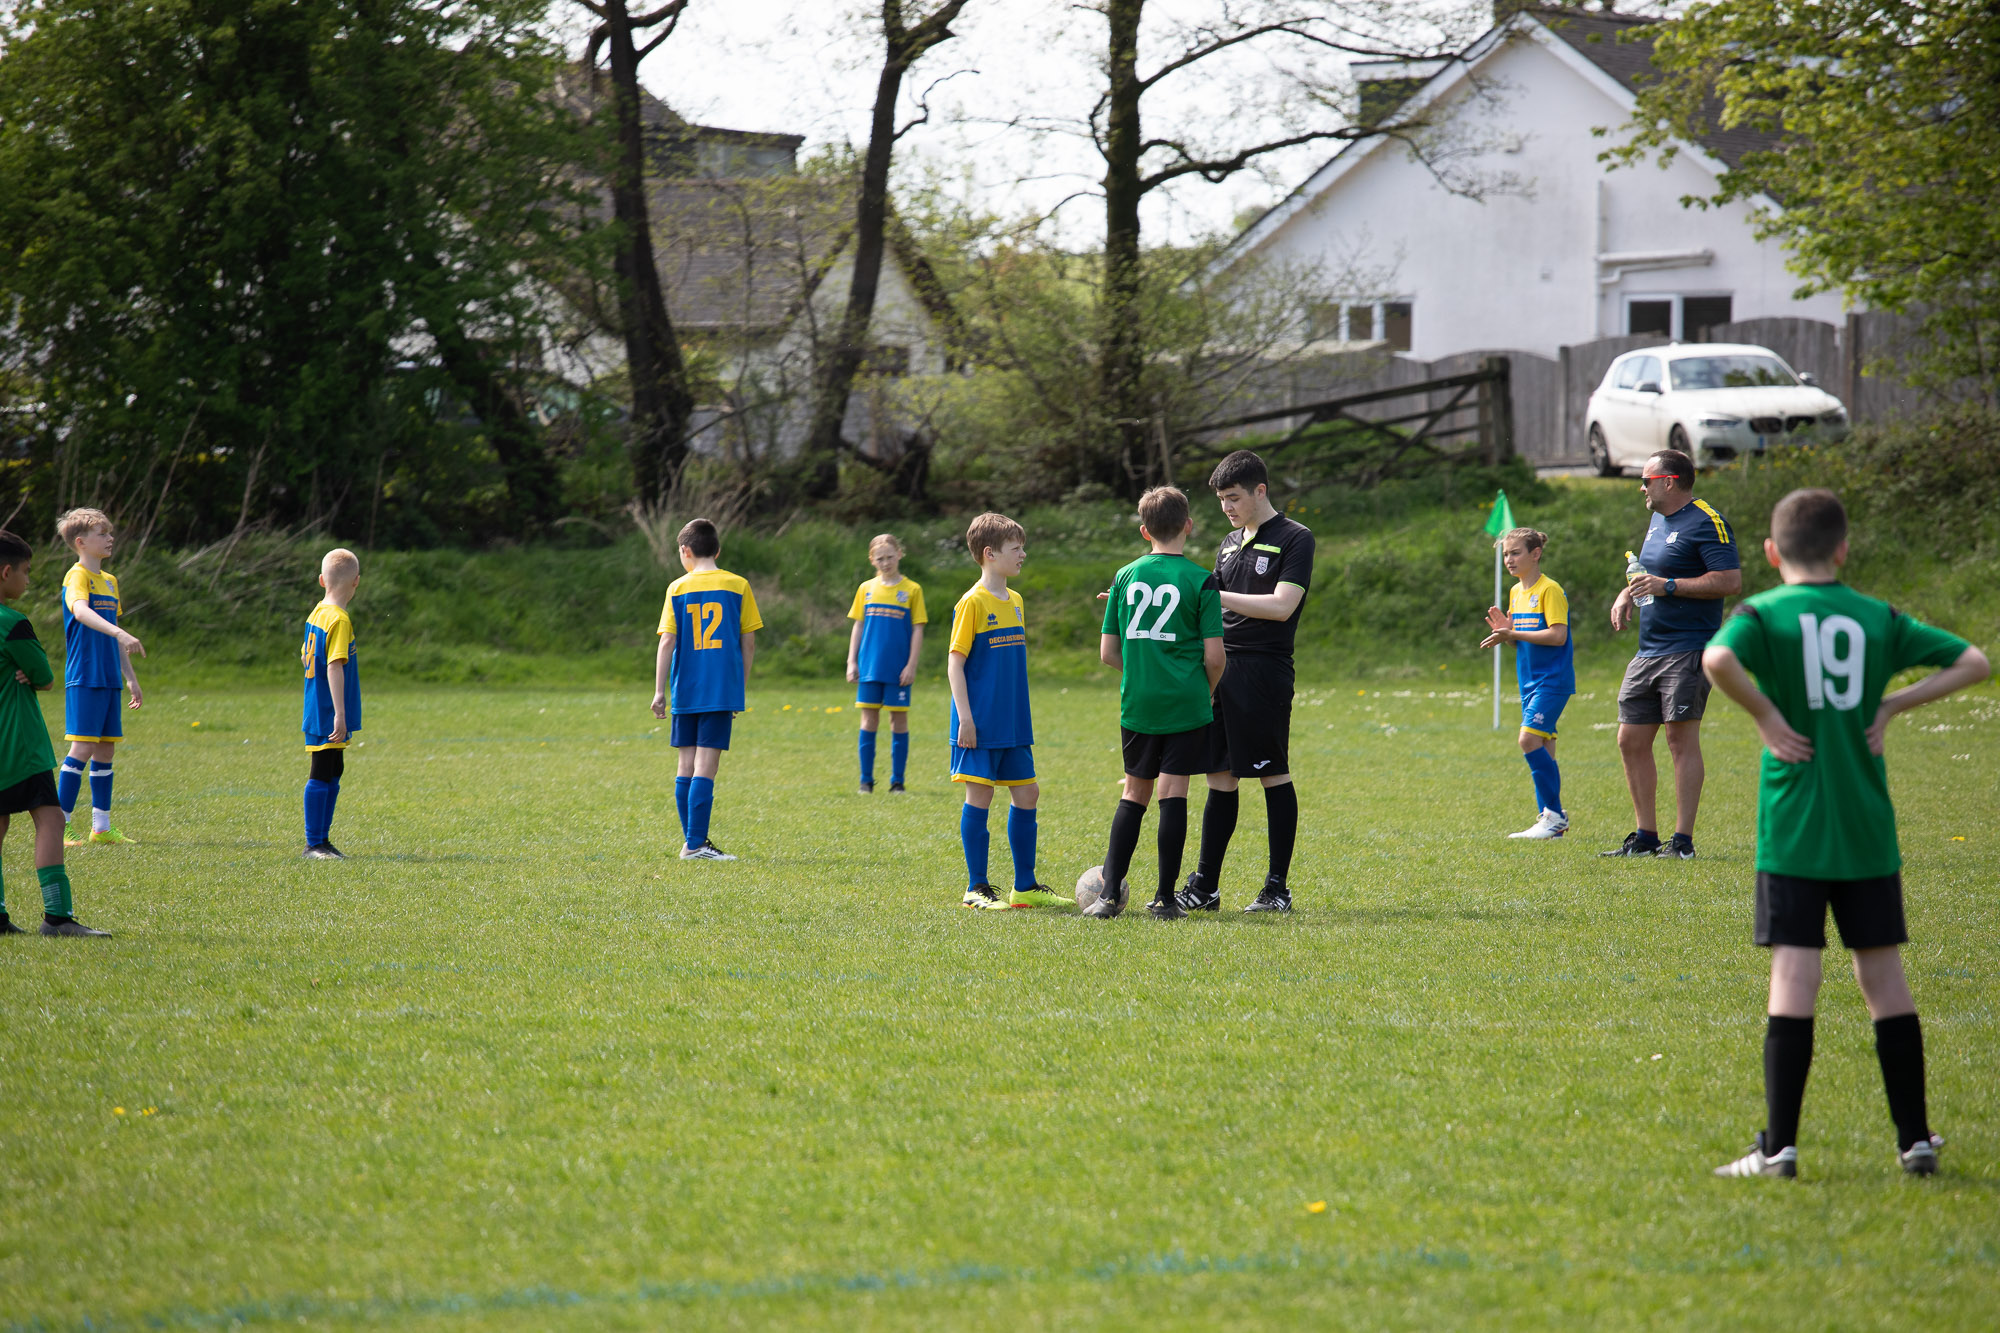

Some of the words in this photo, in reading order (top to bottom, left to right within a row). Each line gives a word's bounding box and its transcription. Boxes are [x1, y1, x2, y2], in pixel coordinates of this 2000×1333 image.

[686, 602, 723, 650] 12
[1126, 581, 1181, 641] 22
[1799, 613, 1866, 710] 19
